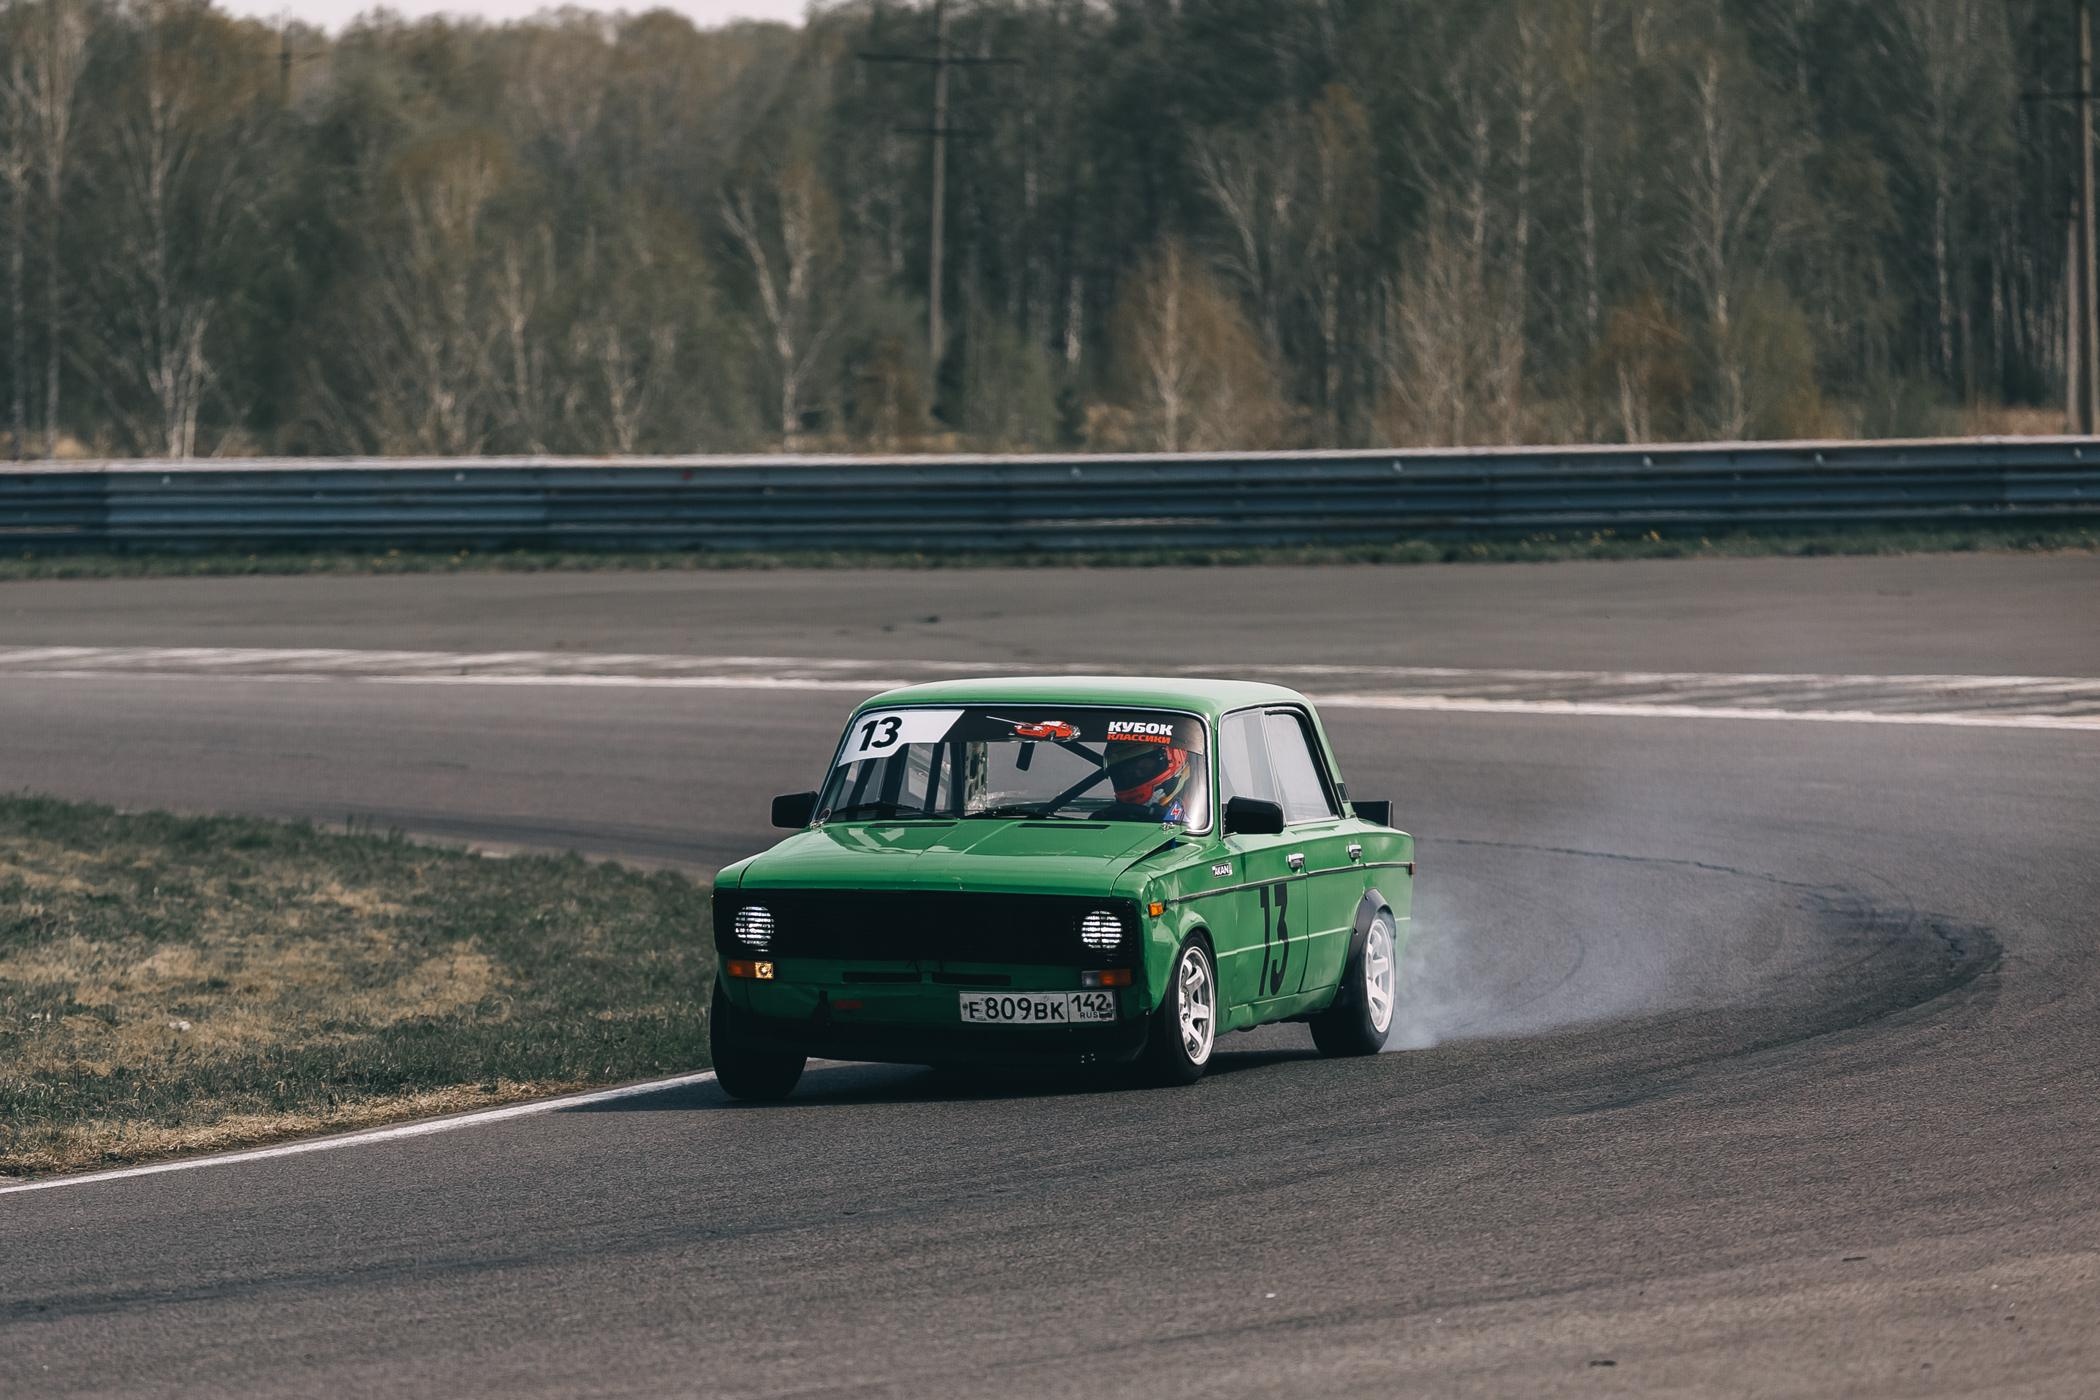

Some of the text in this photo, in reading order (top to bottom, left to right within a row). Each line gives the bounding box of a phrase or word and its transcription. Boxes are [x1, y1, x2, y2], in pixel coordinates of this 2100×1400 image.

[859, 716, 903, 751] 13
[1108, 721, 1173, 736] КУБОК
[1107, 733, 1171, 745] КЛАССИКИ
[1259, 882, 1290, 996] 13
[1071, 993, 1109, 1012] 142
[1079, 1011, 1099, 1019] RUS
